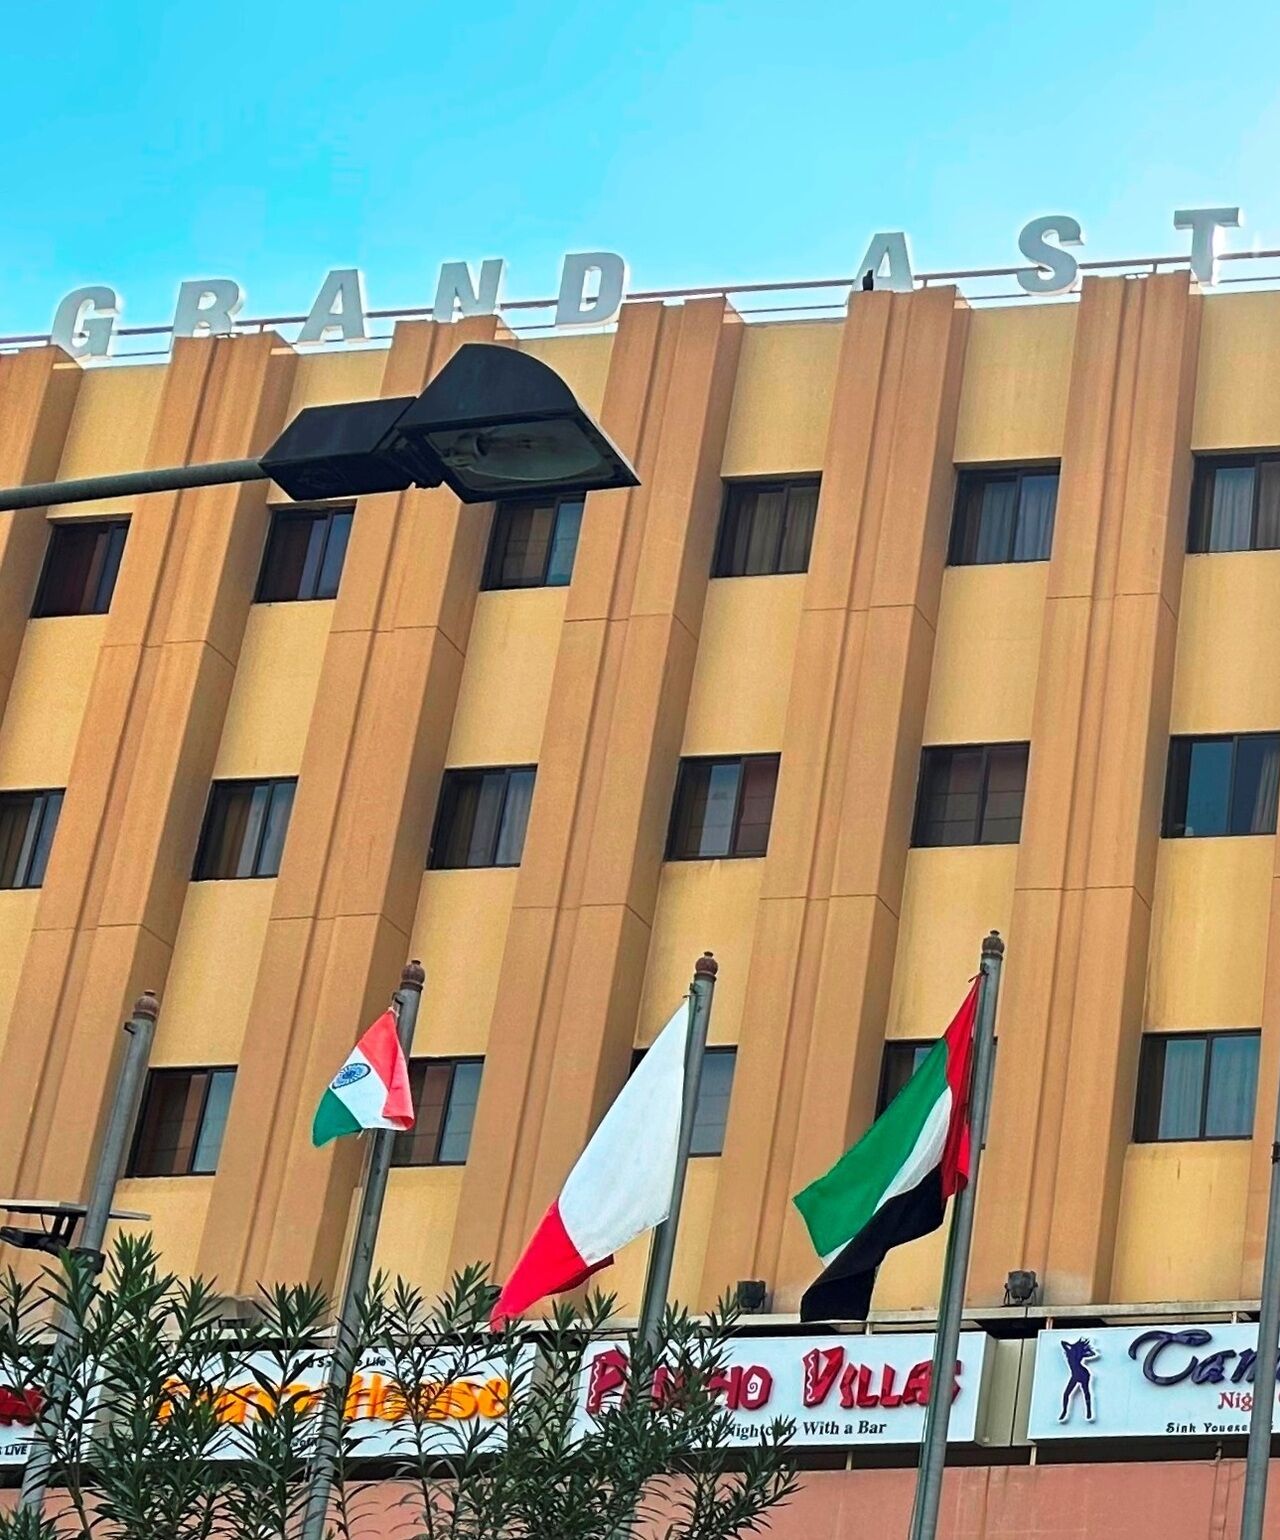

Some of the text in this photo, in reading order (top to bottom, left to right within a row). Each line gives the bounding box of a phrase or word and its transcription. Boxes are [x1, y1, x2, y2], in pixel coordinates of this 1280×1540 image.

[53, 252, 629, 359] GRAND
[1217, 1391, 1254, 1412] Nig
[803, 1420, 839, 1437] With
[844, 1425, 853, 1434] a
[858, 1419, 887, 1434] Bar
[1166, 1422, 1196, 1433] Sink
